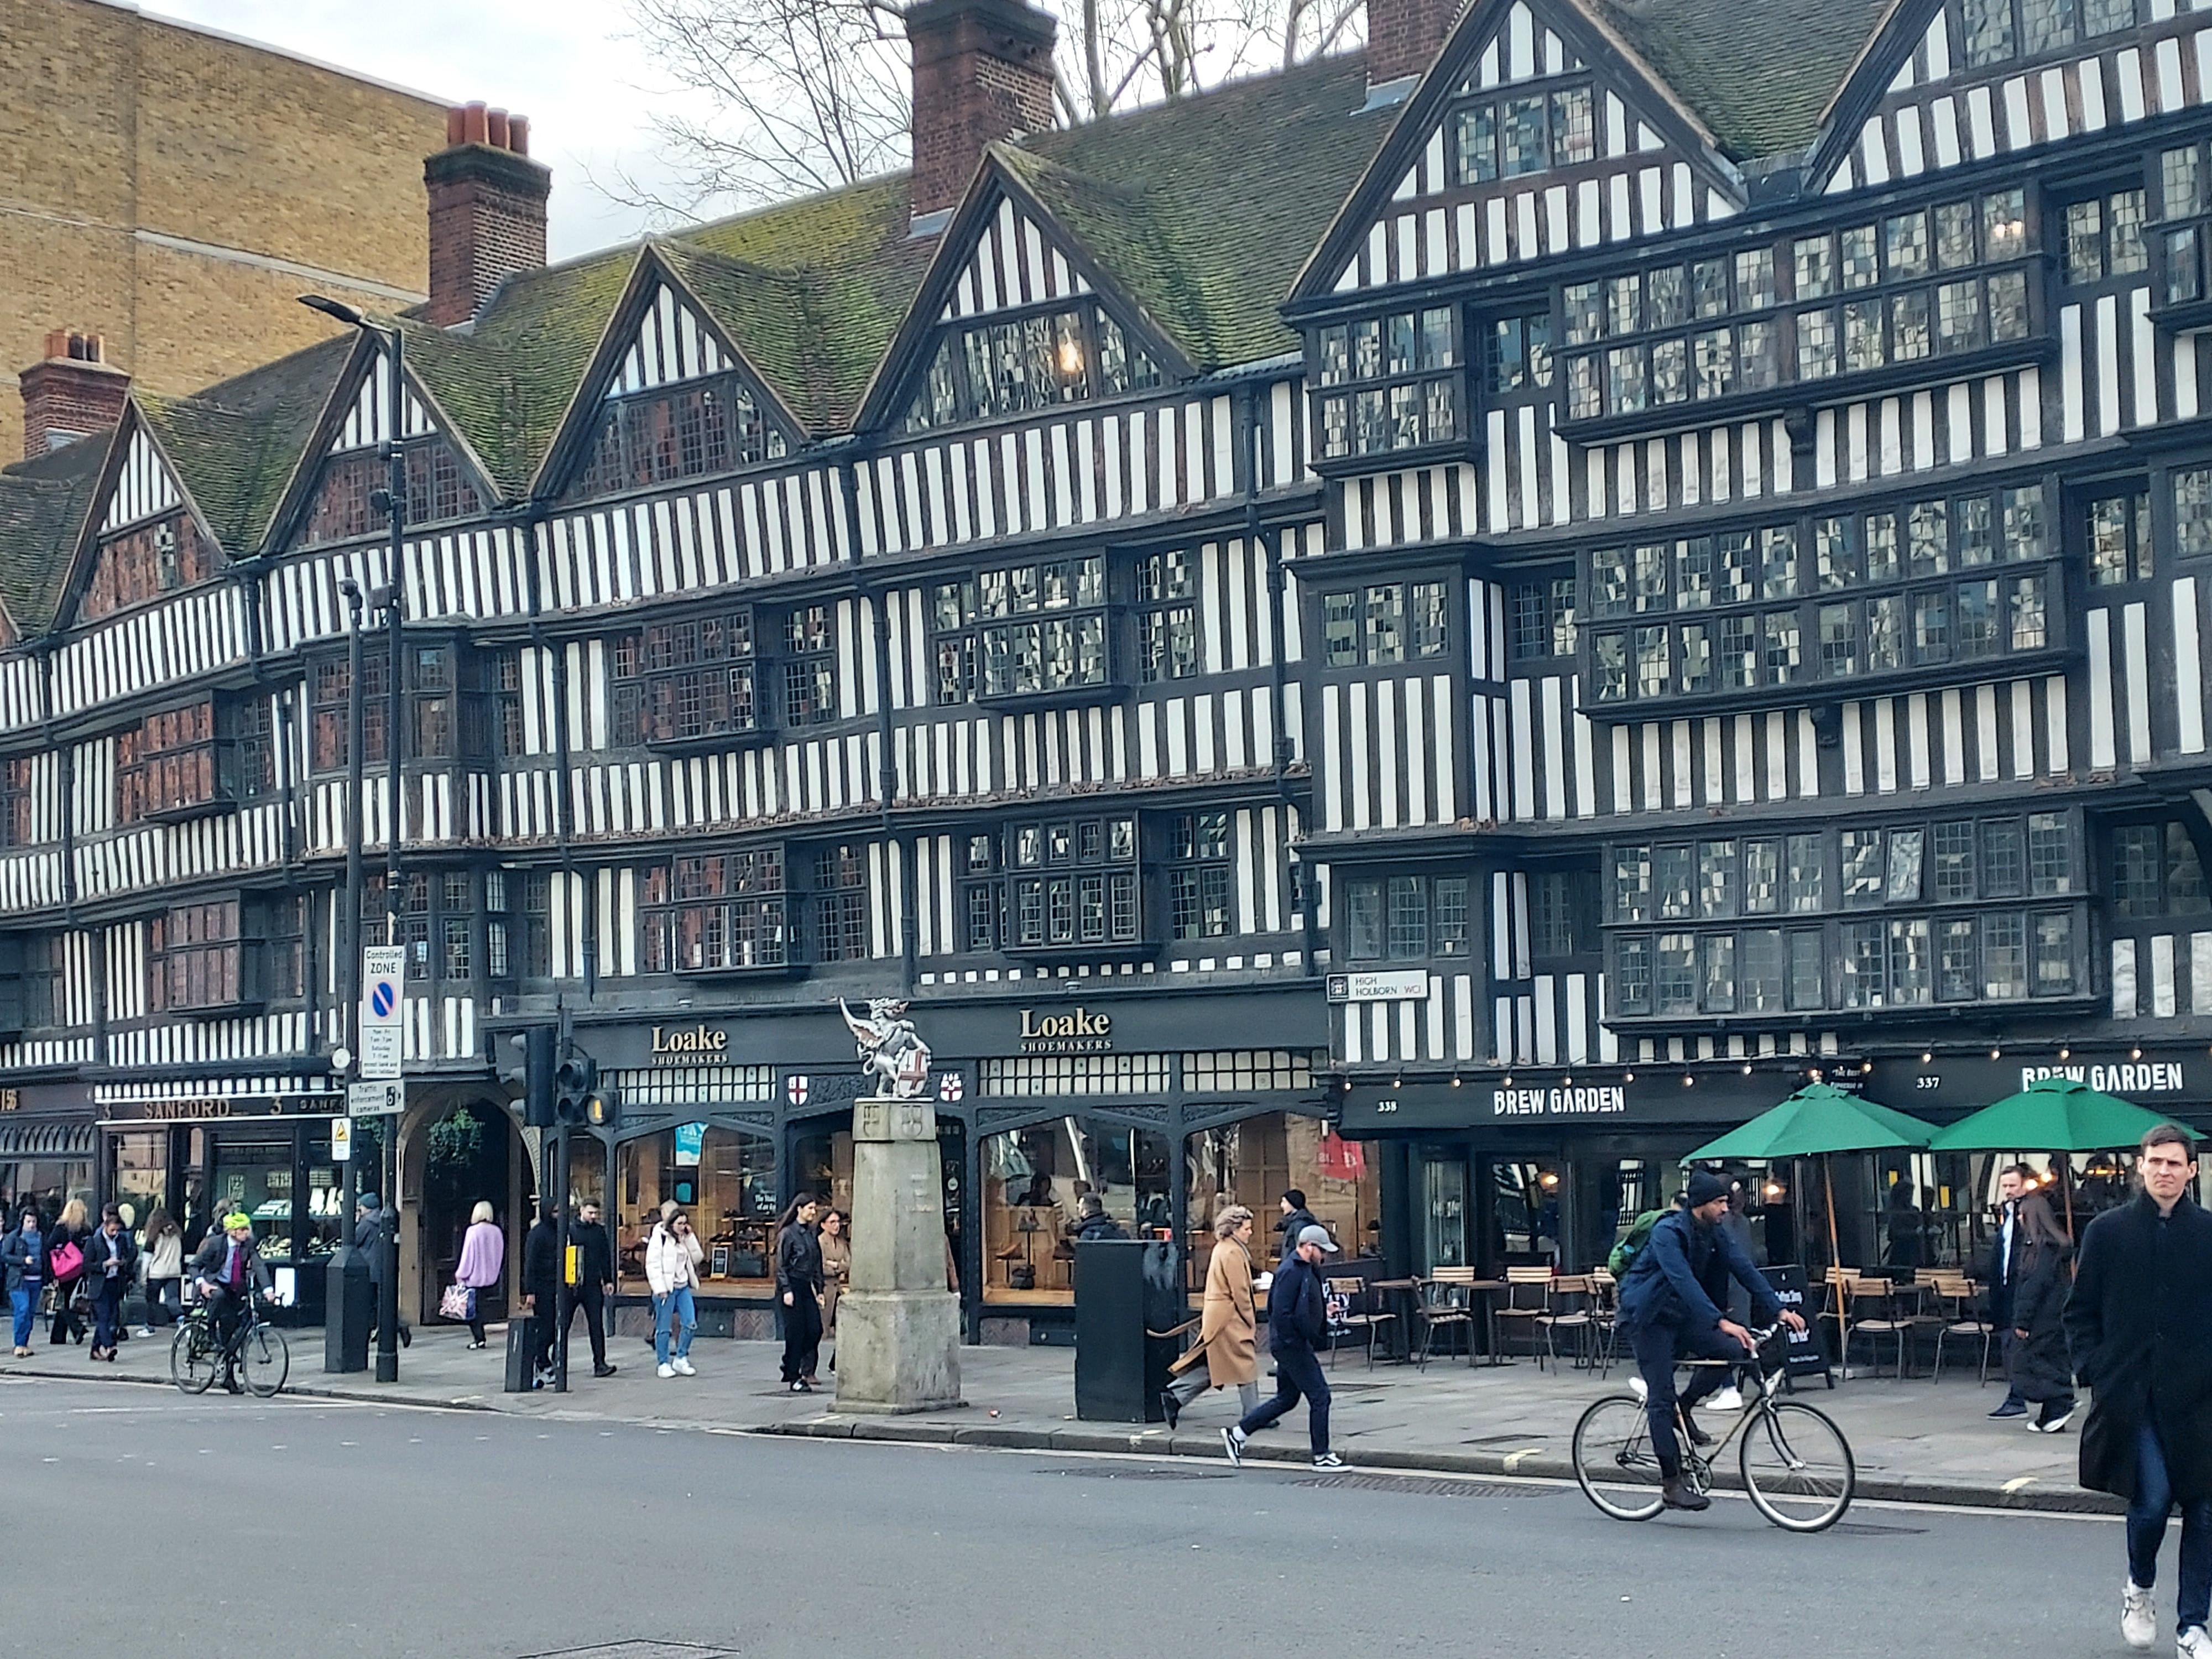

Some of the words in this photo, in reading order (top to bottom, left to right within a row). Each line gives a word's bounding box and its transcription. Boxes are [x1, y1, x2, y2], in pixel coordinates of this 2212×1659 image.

[366, 950, 403, 959] Controlled
[371, 962, 397, 974] ZONE
[1355, 977, 1378, 986] HIGH
[1355, 986, 1397, 997] HOLBORN
[1019, 1007, 1110, 1038] Loake
[651, 1024, 727, 1052] Loake
[1020, 1039, 1113, 1052] SHOEMAKERS
[651, 1053, 729, 1066] SHOEMAKERS
[1916, 1076, 1940, 1089] 337
[2090, 1062, 2184, 1092] GARDEN
[1377, 1100, 1397, 1112] 338
[1493, 1088, 1546, 1116] BREW
[1549, 1086, 1625, 1113] GARDEN
[144, 1098, 230, 1120] SANFORD
[270, 1097, 283, 1115] 3
